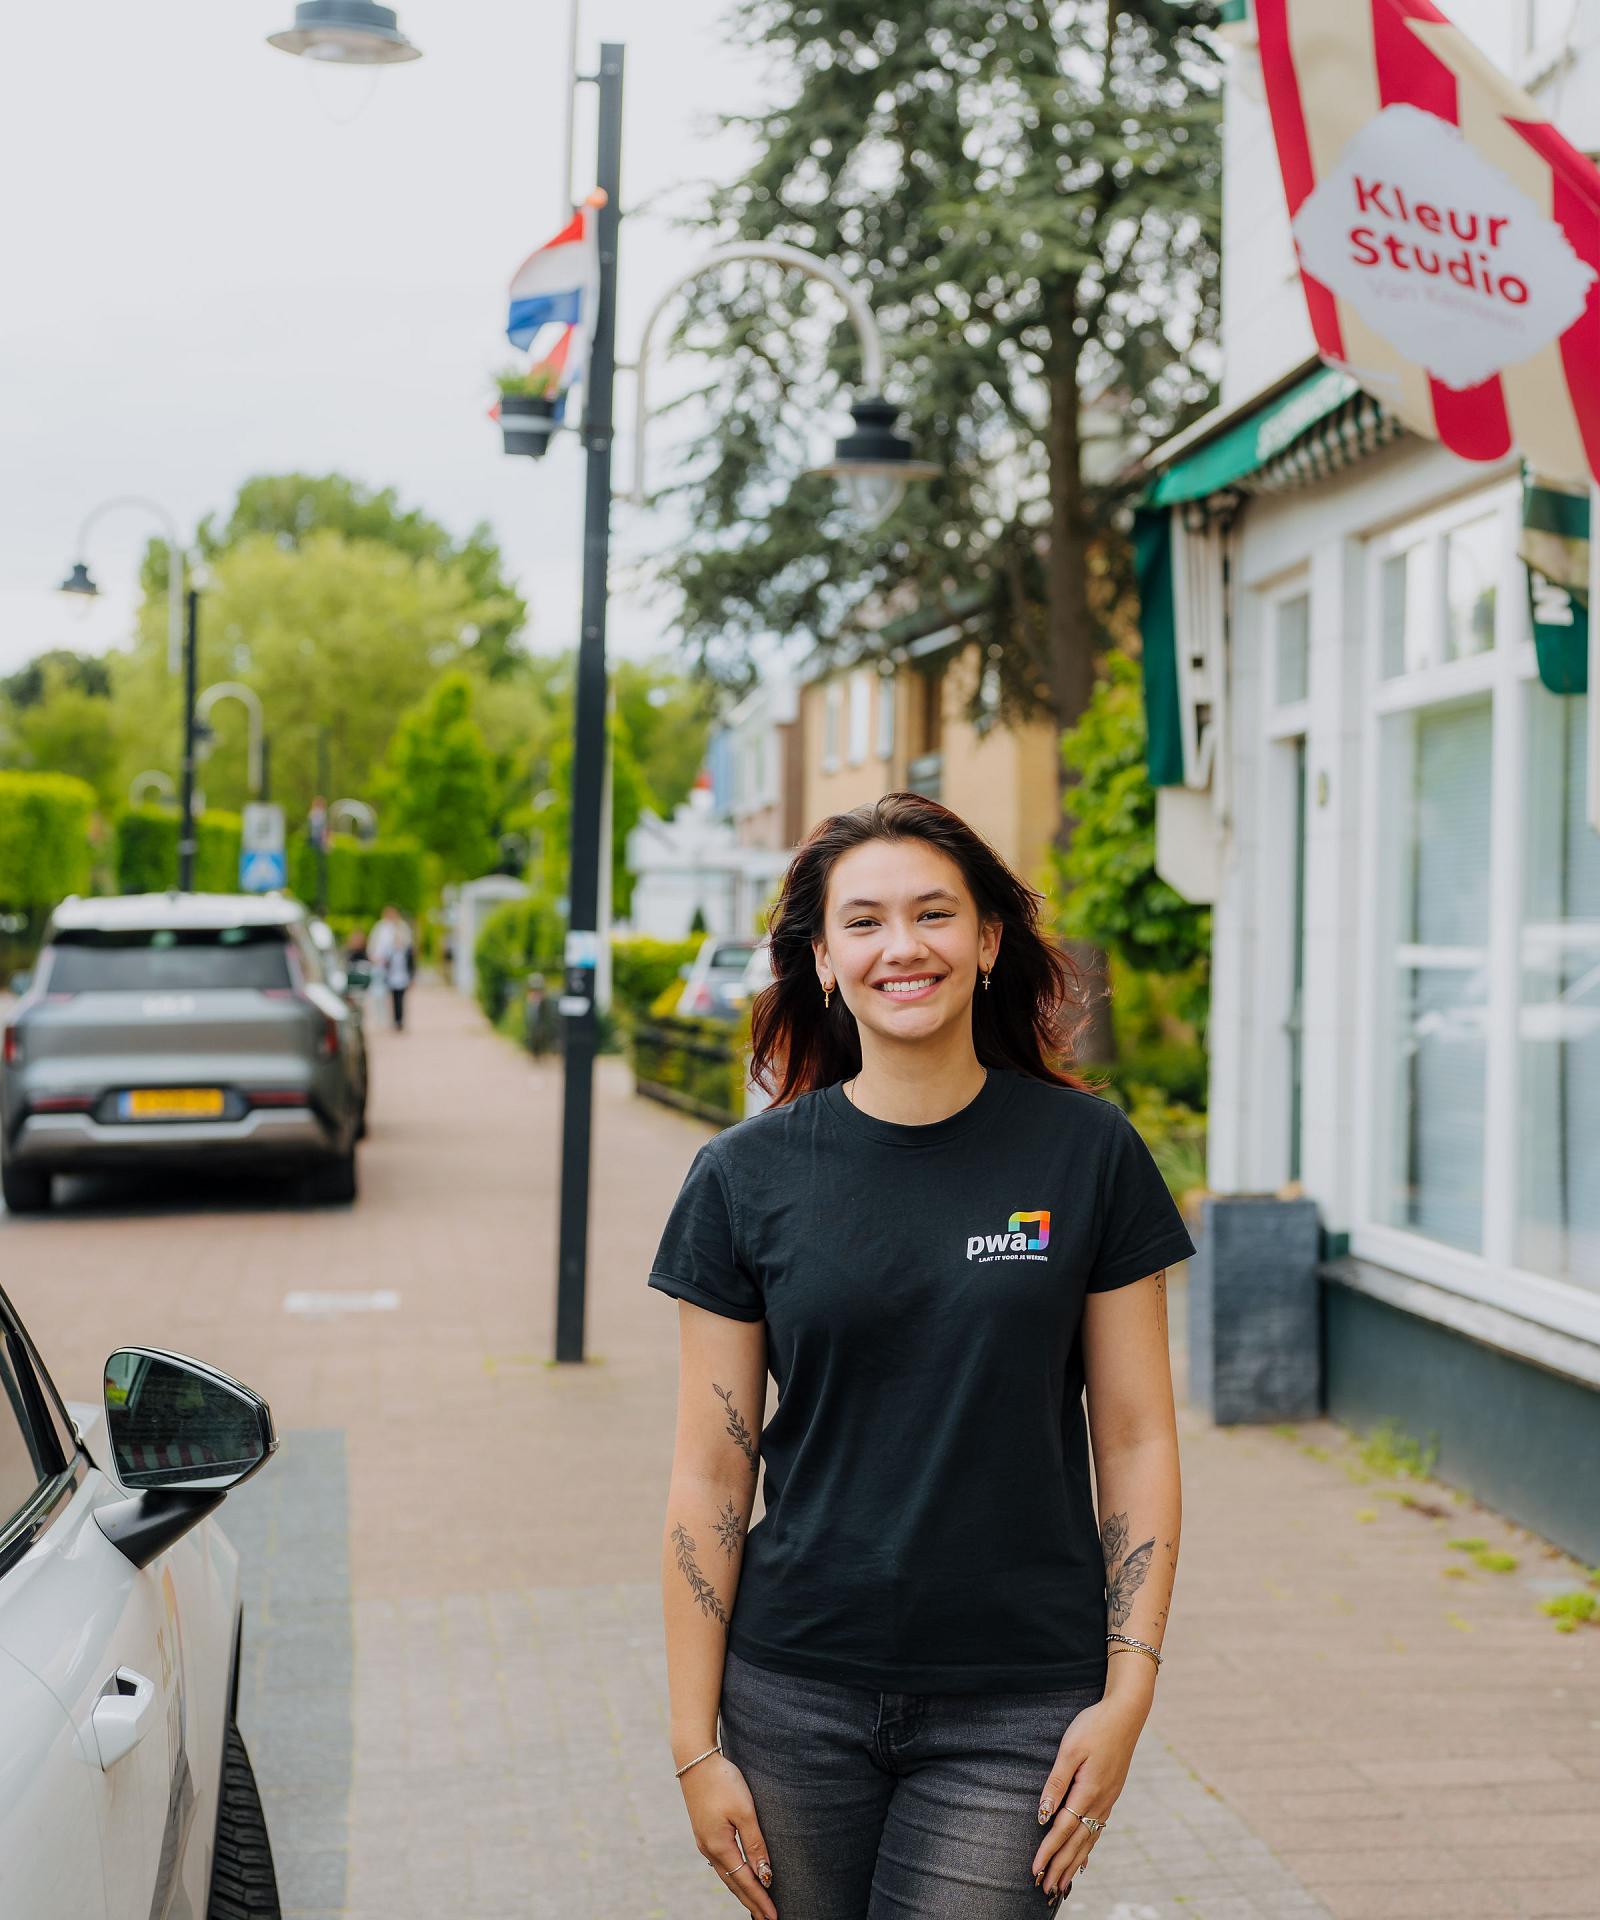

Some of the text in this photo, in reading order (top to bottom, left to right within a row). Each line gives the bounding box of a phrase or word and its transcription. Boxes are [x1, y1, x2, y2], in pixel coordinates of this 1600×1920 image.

[1353, 174, 1509, 249] Kleur
[1349, 226, 1530, 305] Studio
[966, 1232, 1027, 1260] pwa
